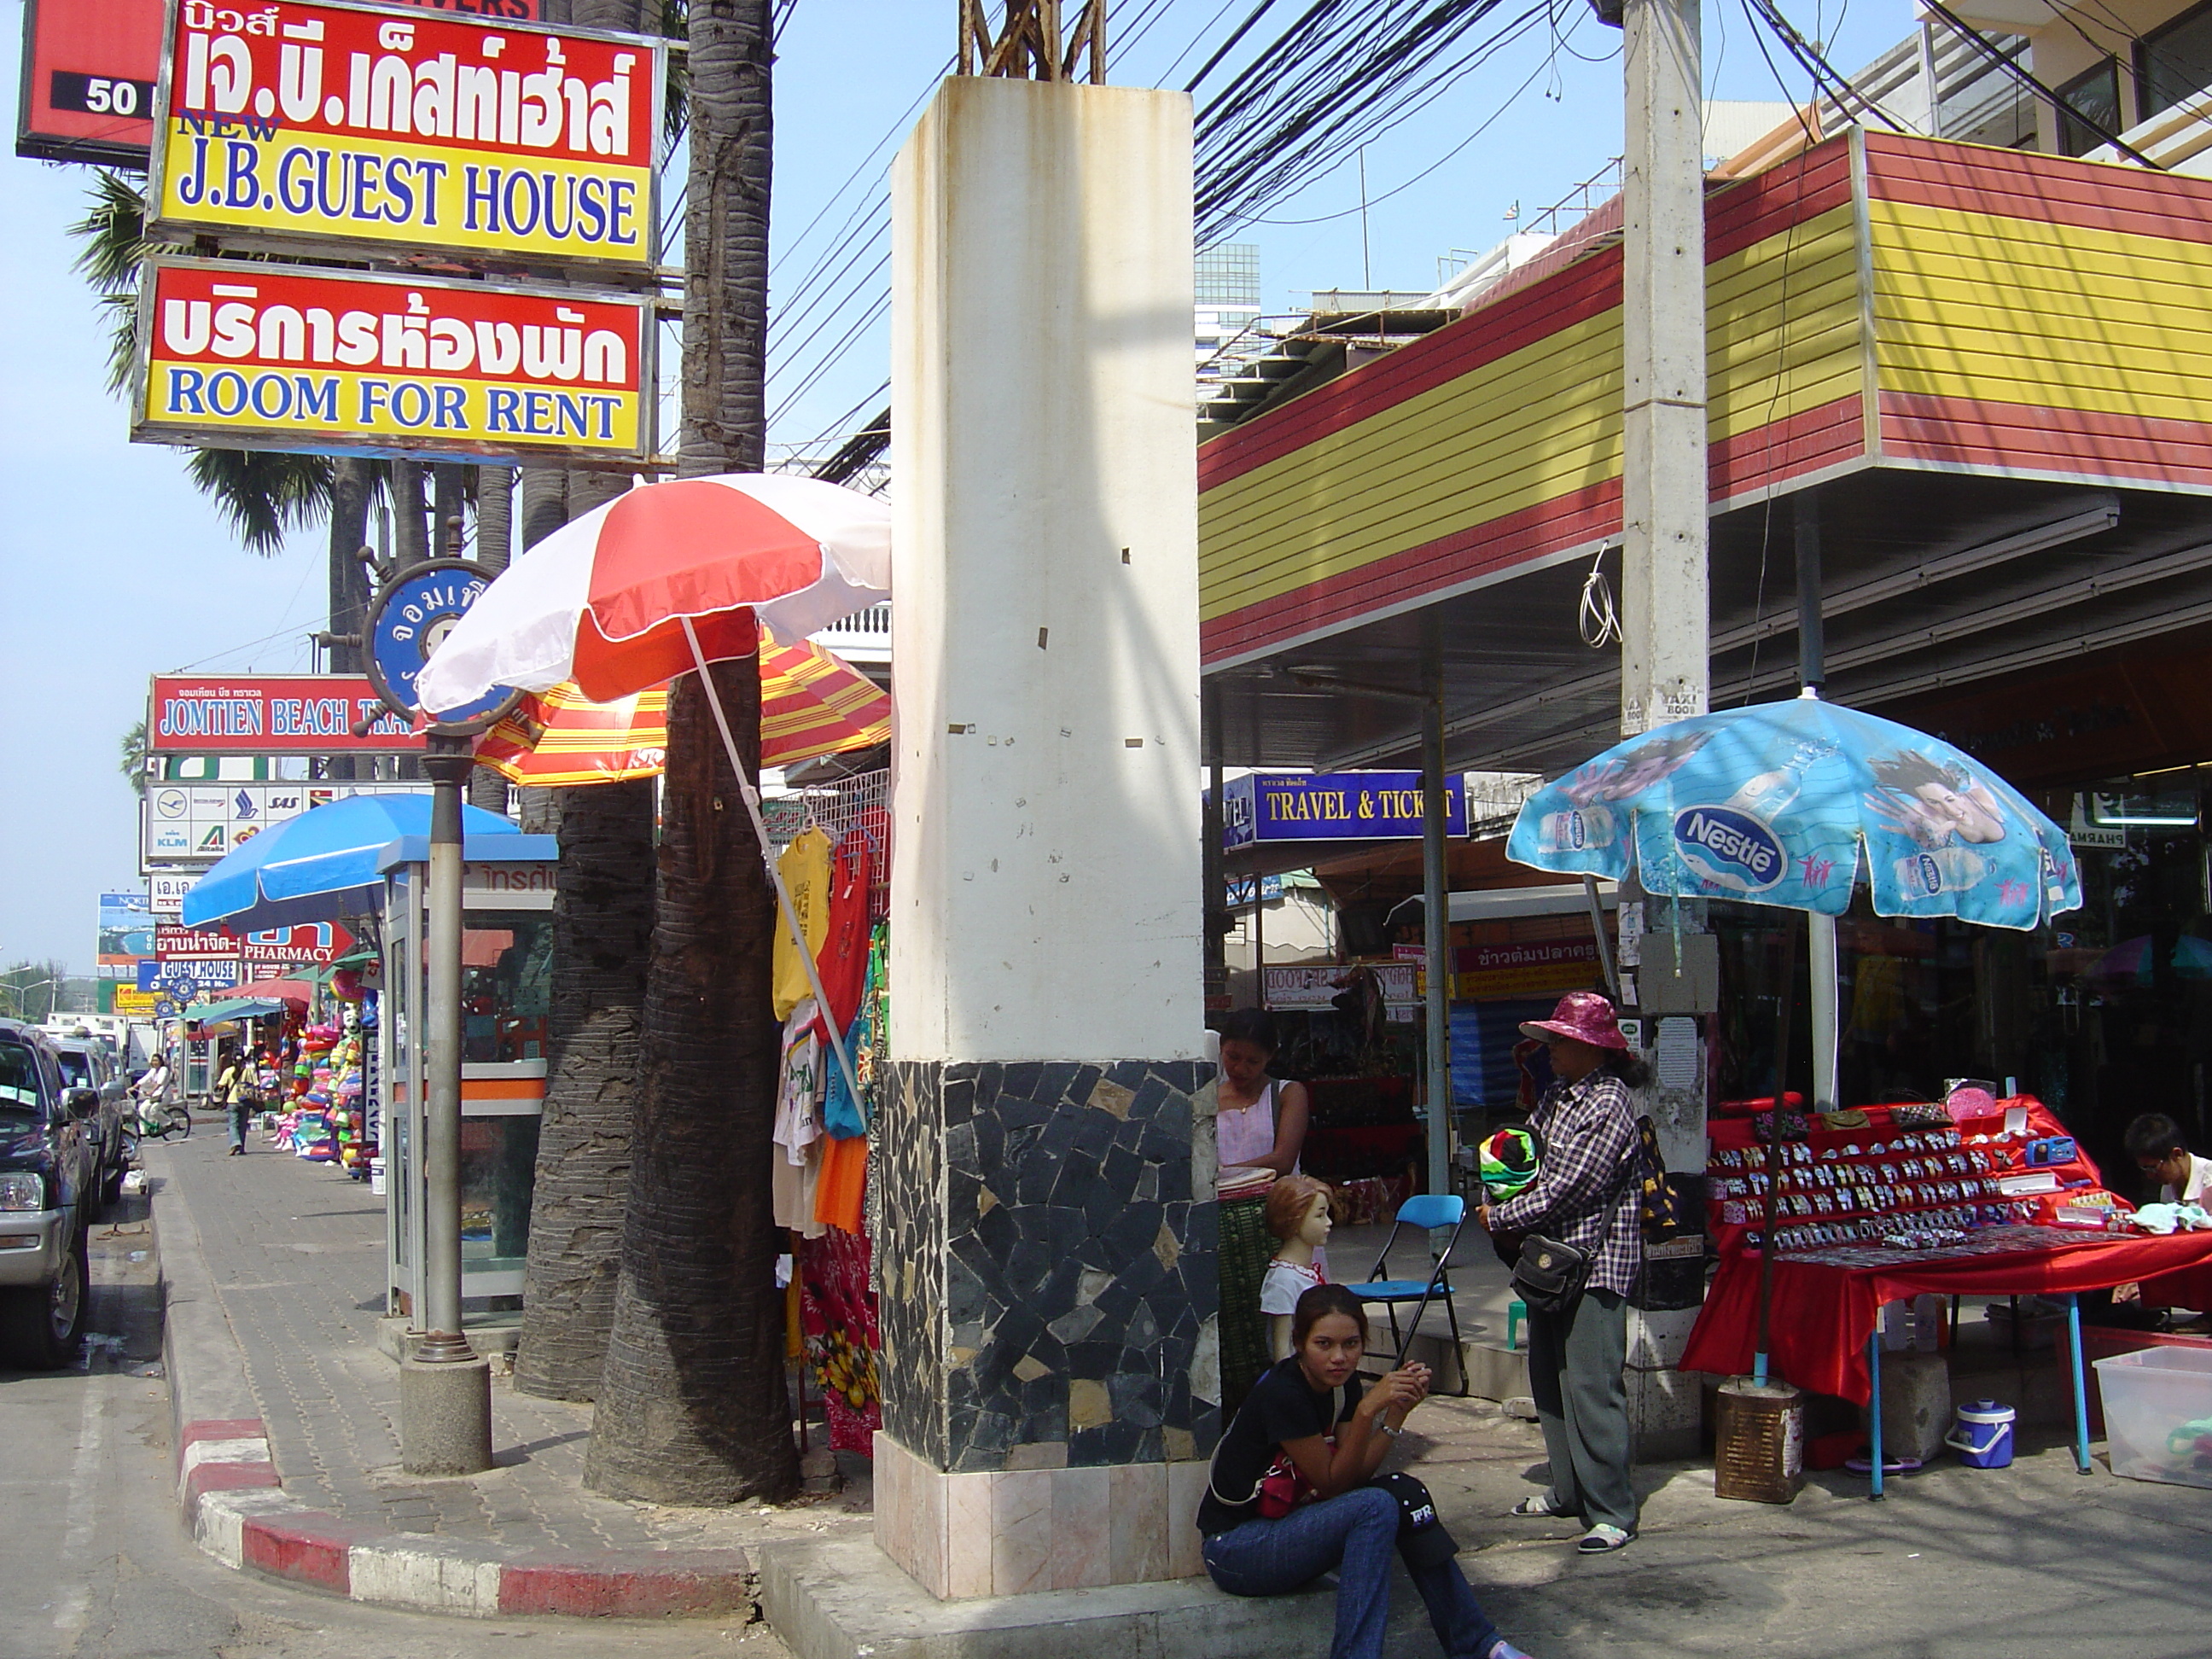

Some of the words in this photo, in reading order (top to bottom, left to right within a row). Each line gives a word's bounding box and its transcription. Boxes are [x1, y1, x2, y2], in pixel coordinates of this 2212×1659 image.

[85, 79, 137, 115] 50
[176, 108, 284, 143] NEW
[463, 166, 637, 246] HOUSE
[163, 283, 627, 384] บริการห้องพัก
[167, 368, 341, 424] ROOM
[358, 381, 469, 429] FOR
[486, 389, 622, 439] RENT
[160, 698, 263, 736] JOMTIEN
[271, 698, 348, 736] BEACH
[267, 797, 300, 809] SAS
[1266, 790, 1351, 821] TRAVEL
[1358, 789, 1376, 819] &
[158, 838, 188, 847] KLM
[1686, 812, 1777, 873] Nestlé
[166, 961, 197, 978] GUEST
[198, 961, 234, 978] HOUSE
[244, 946, 335, 962] PHARMACY
